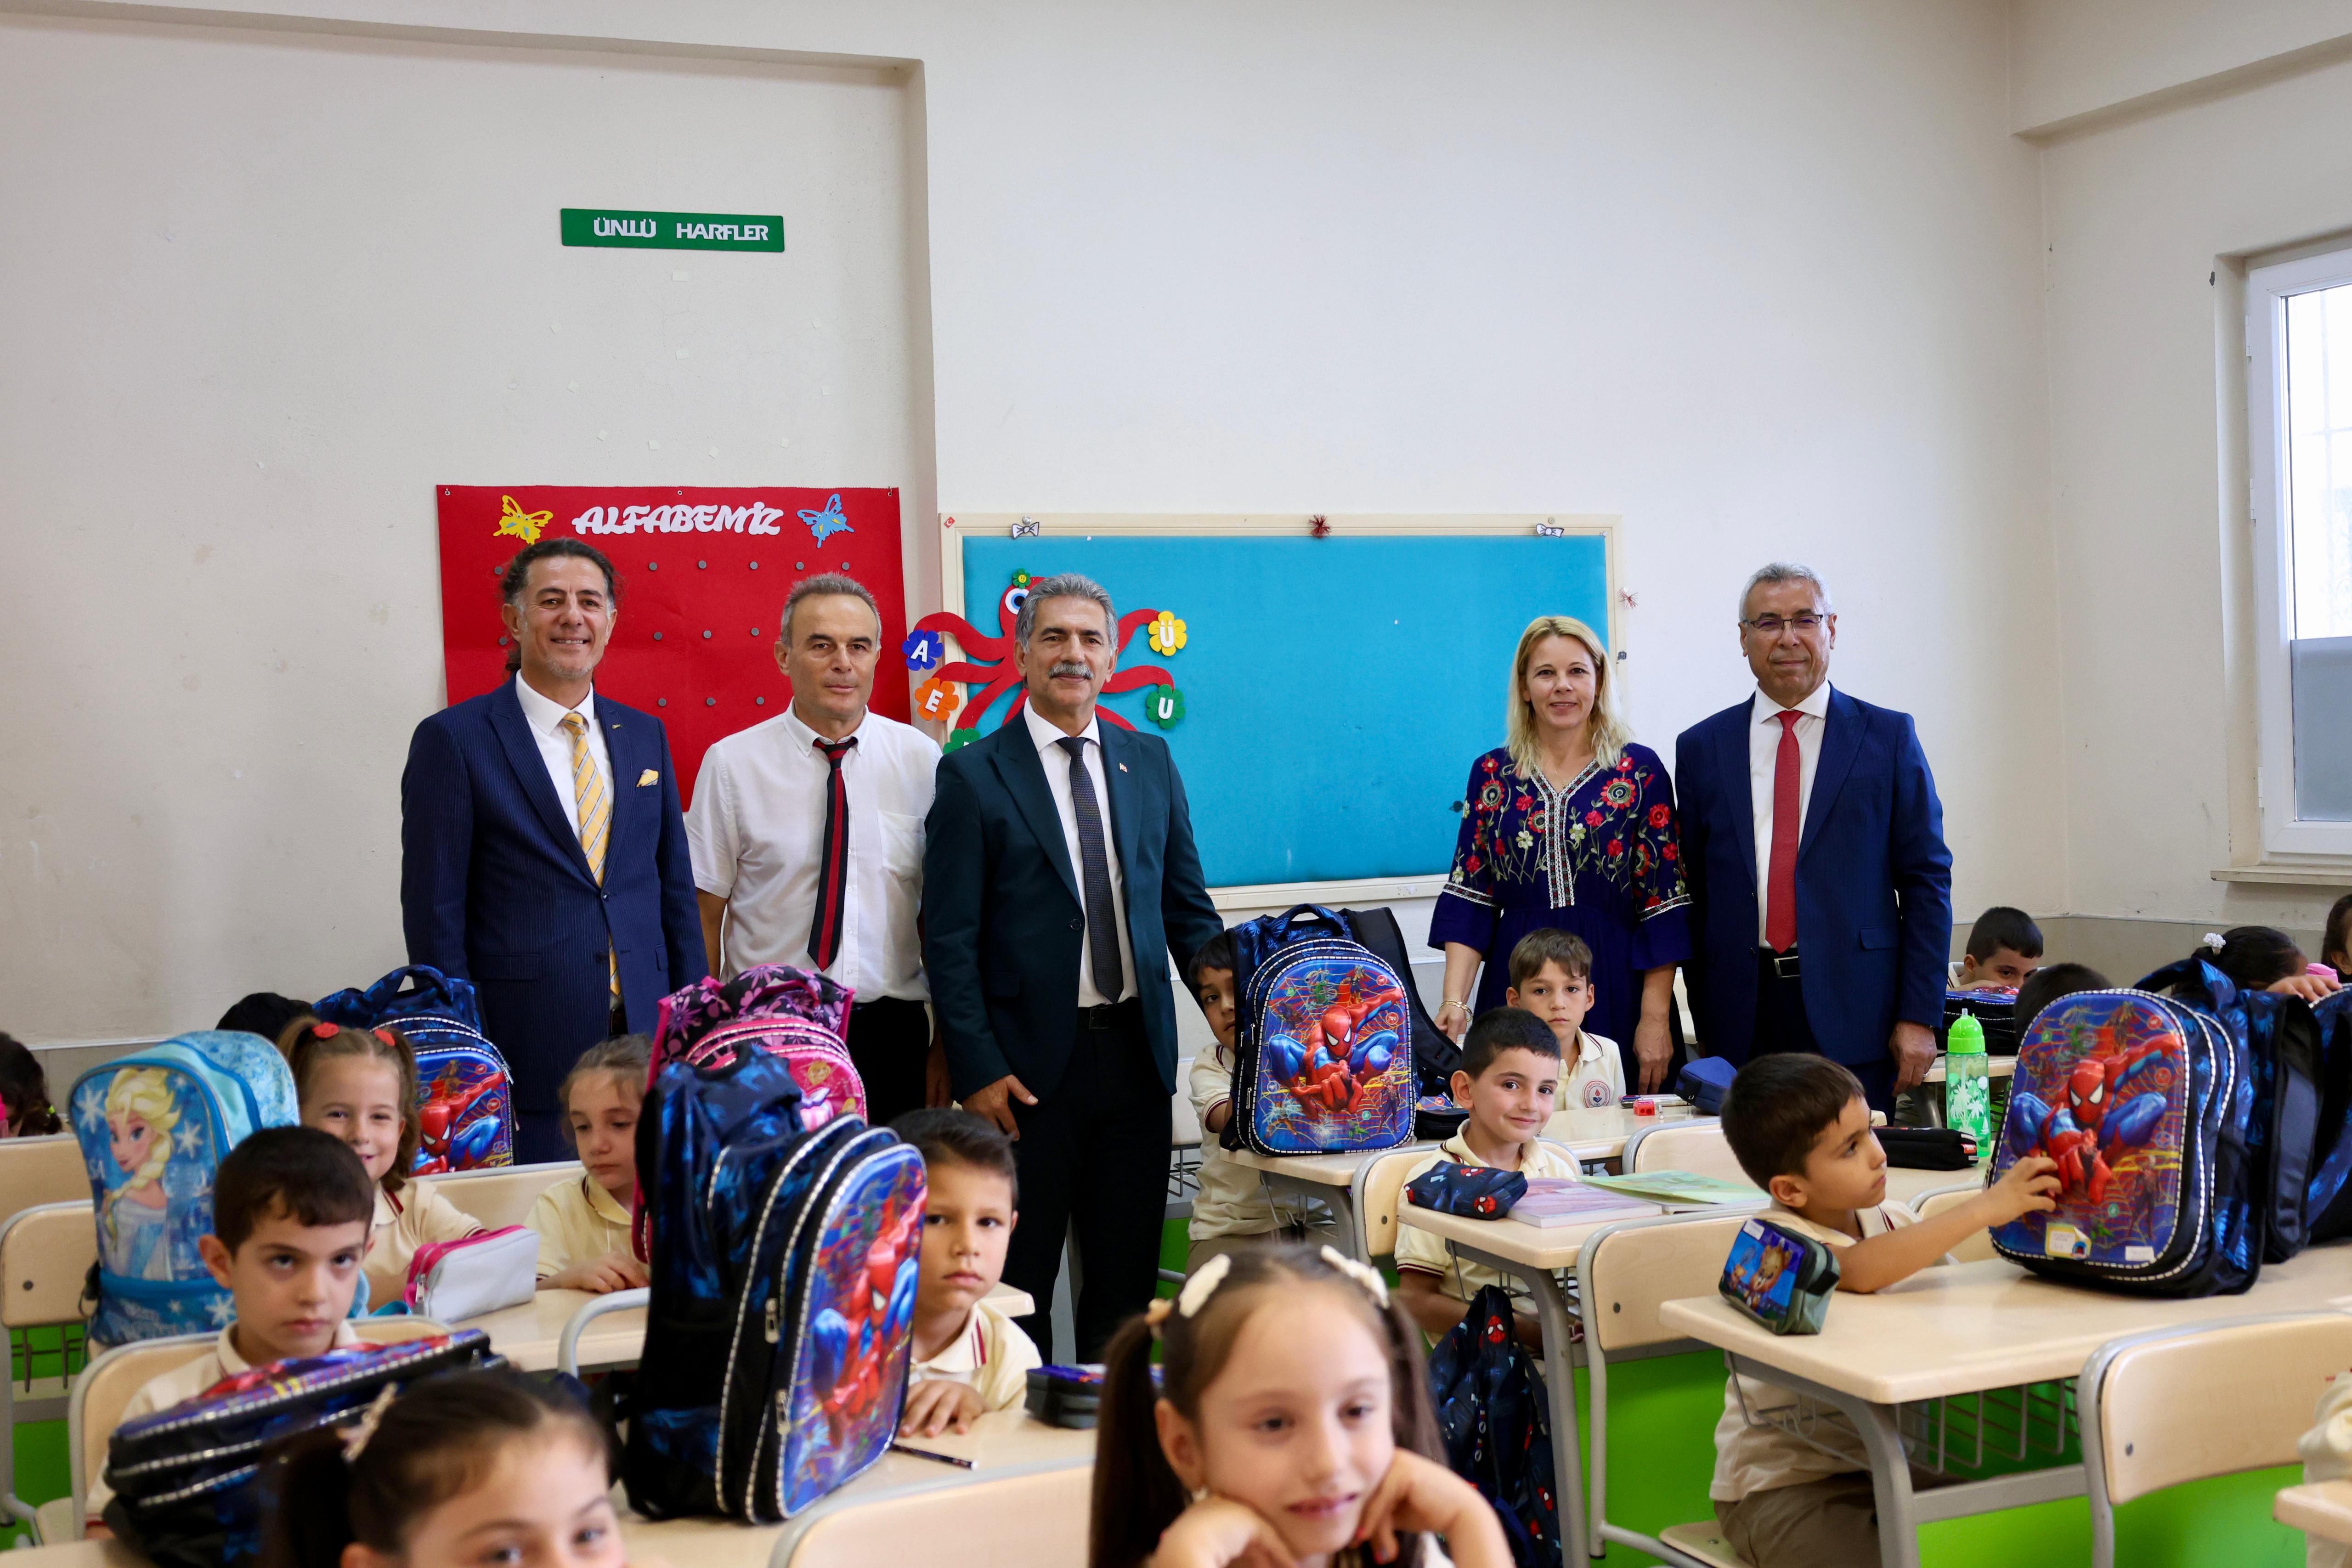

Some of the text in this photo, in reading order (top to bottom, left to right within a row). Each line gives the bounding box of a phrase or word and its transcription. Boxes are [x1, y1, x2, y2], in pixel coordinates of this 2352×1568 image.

[594, 217, 769, 241] ÜNLÜ HARFLER
[572, 502, 784, 535] ALFABEMİZ
[1159, 620, 1174, 647] Ü
[911, 640, 928, 662] A
[925, 689, 944, 712] E
[1158, 697, 1173, 719] U
